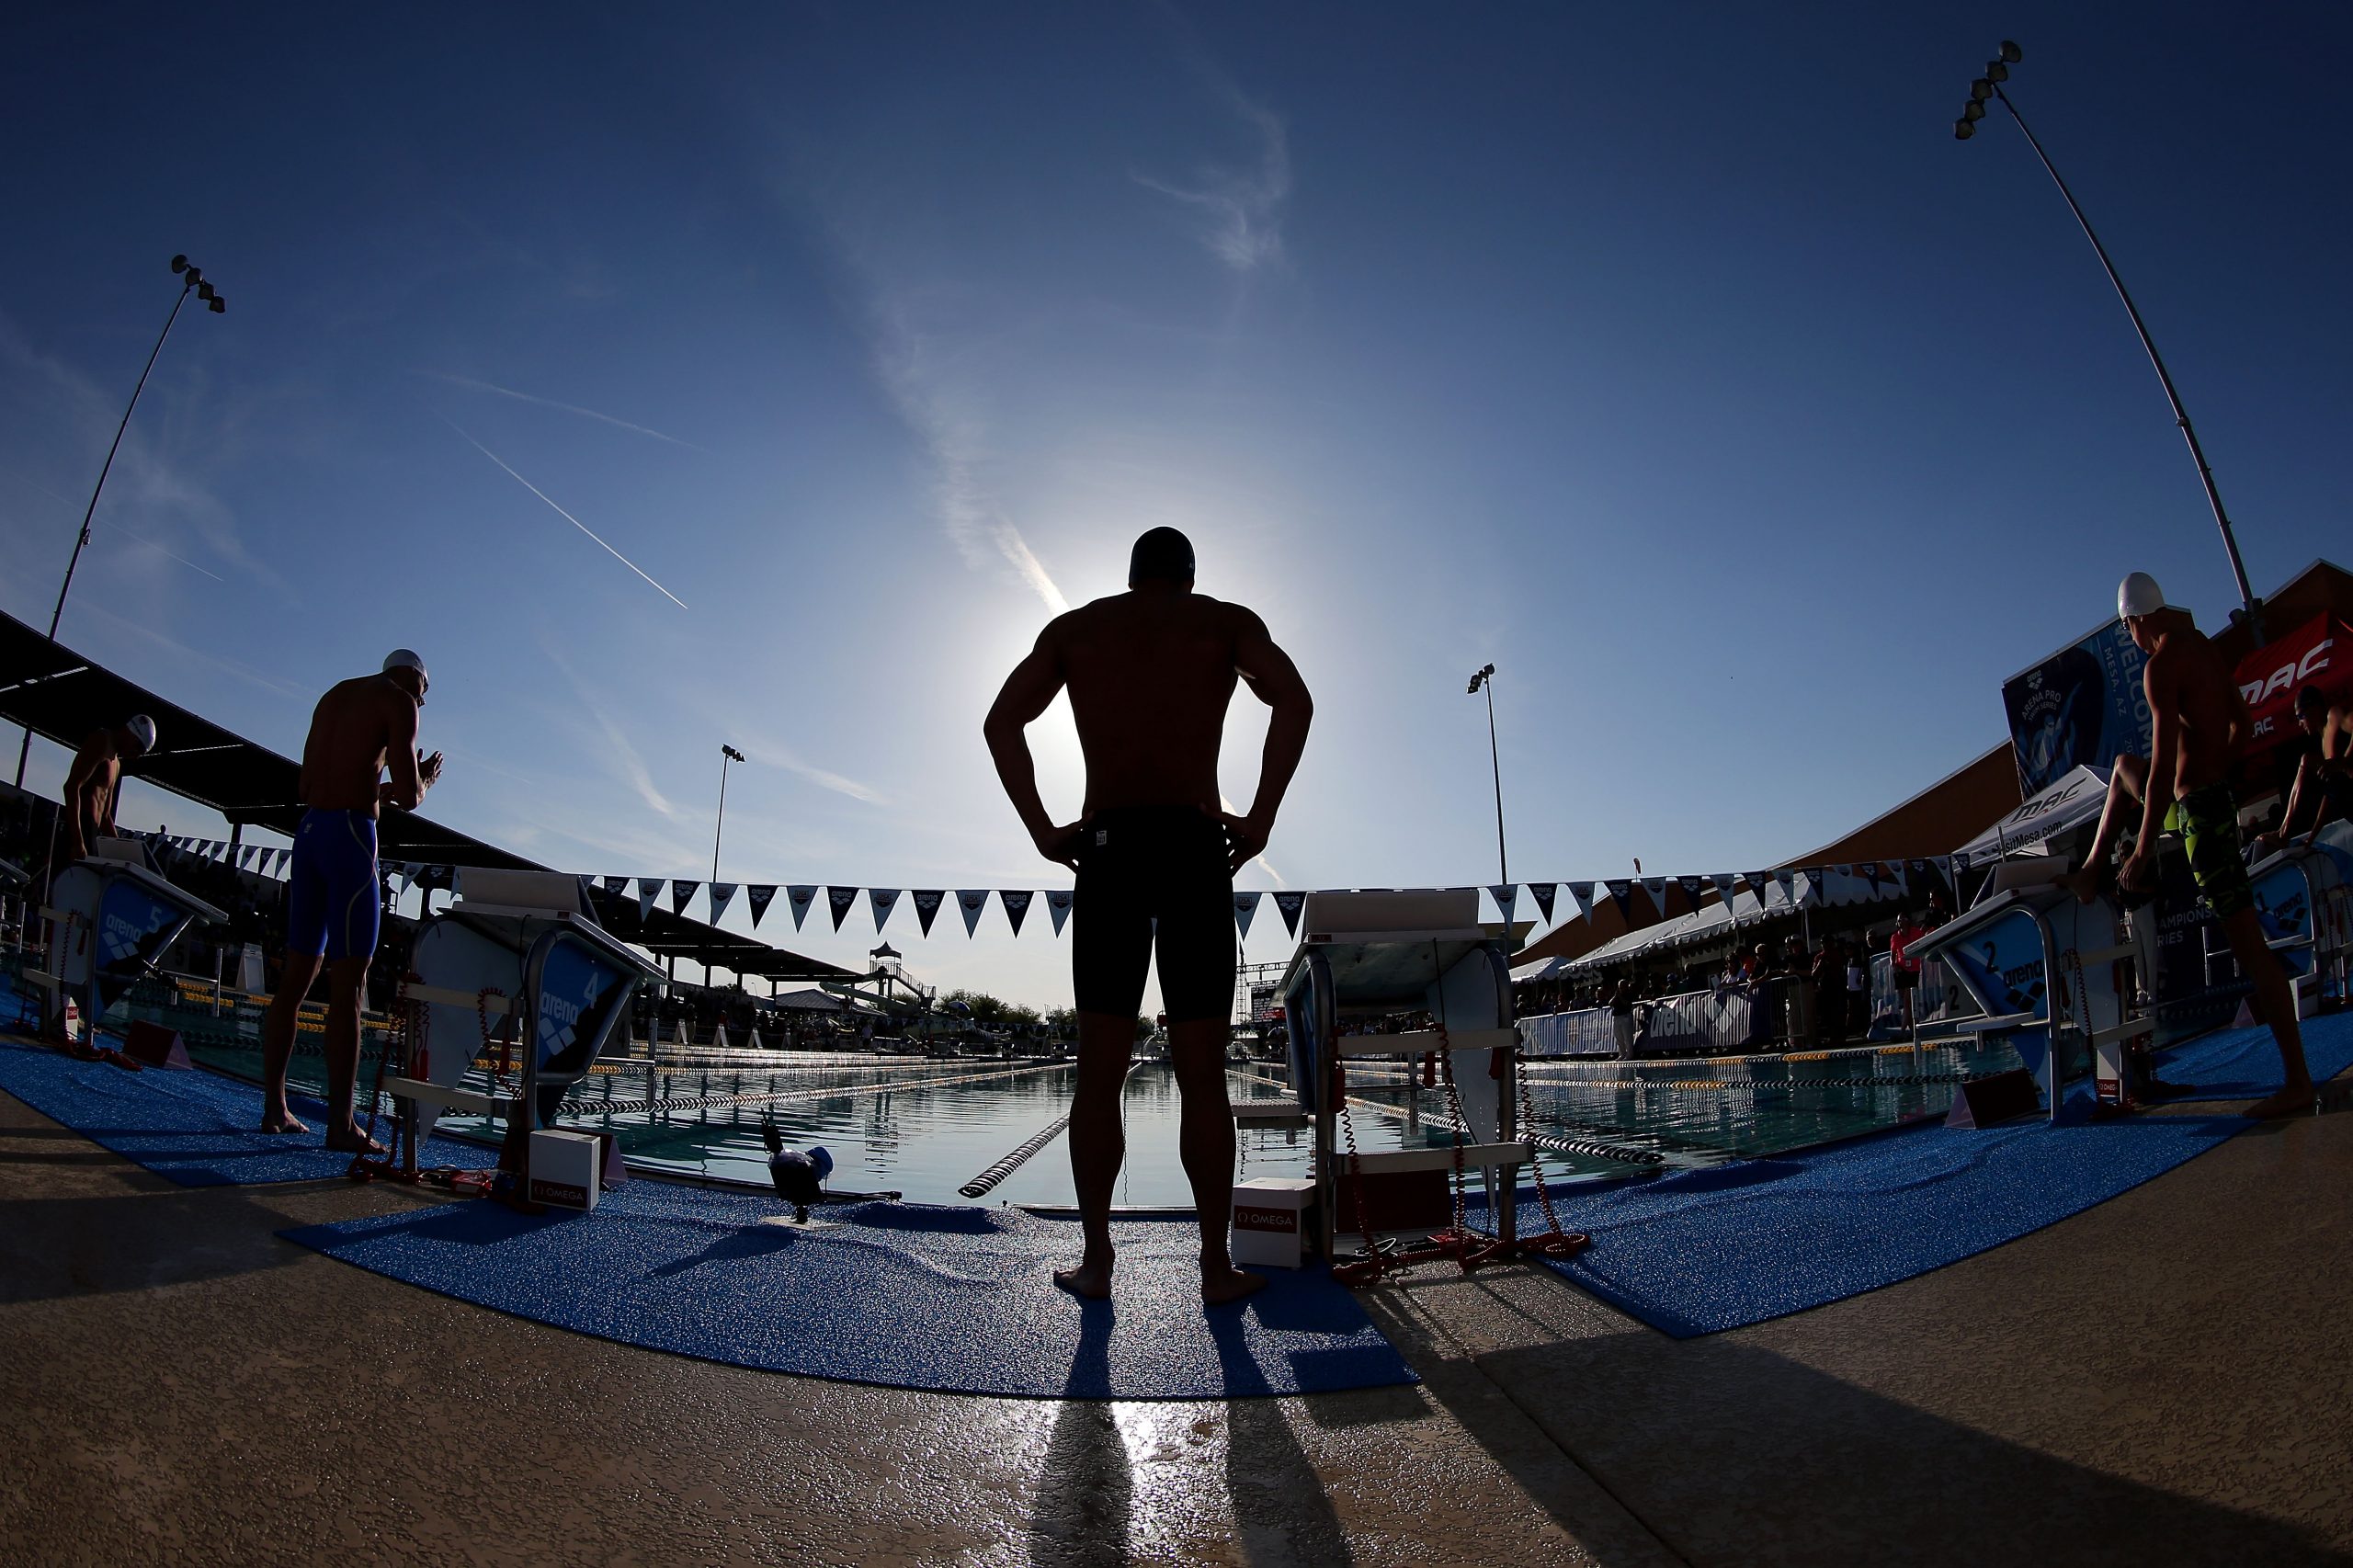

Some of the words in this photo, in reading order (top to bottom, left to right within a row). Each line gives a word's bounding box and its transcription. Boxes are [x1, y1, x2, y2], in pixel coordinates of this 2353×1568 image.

[2104, 646, 2119, 692] MESA,
[2116, 698, 2127, 718] AZ
[2115, 625, 2153, 760] WELCOM
[2022, 691, 2044, 721] ARENA
[2045, 689, 2061, 702] PRO
[831, 890, 852, 898] arena
[2256, 891, 2269, 913] 1
[2274, 892, 2302, 919] arena
[106, 913, 142, 943] arena
[147, 905, 163, 934] 5
[1984, 940, 1999, 974] 2
[2003, 959, 2044, 987] arena
[583, 971, 599, 1010] 4
[1949, 984, 1960, 1011] 2
[540, 991, 579, 1026] arena
[1650, 1002, 1697, 1038] arena
[546, 1187, 585, 1201] OMEGA
[1251, 1213, 1293, 1226] OMEGA
